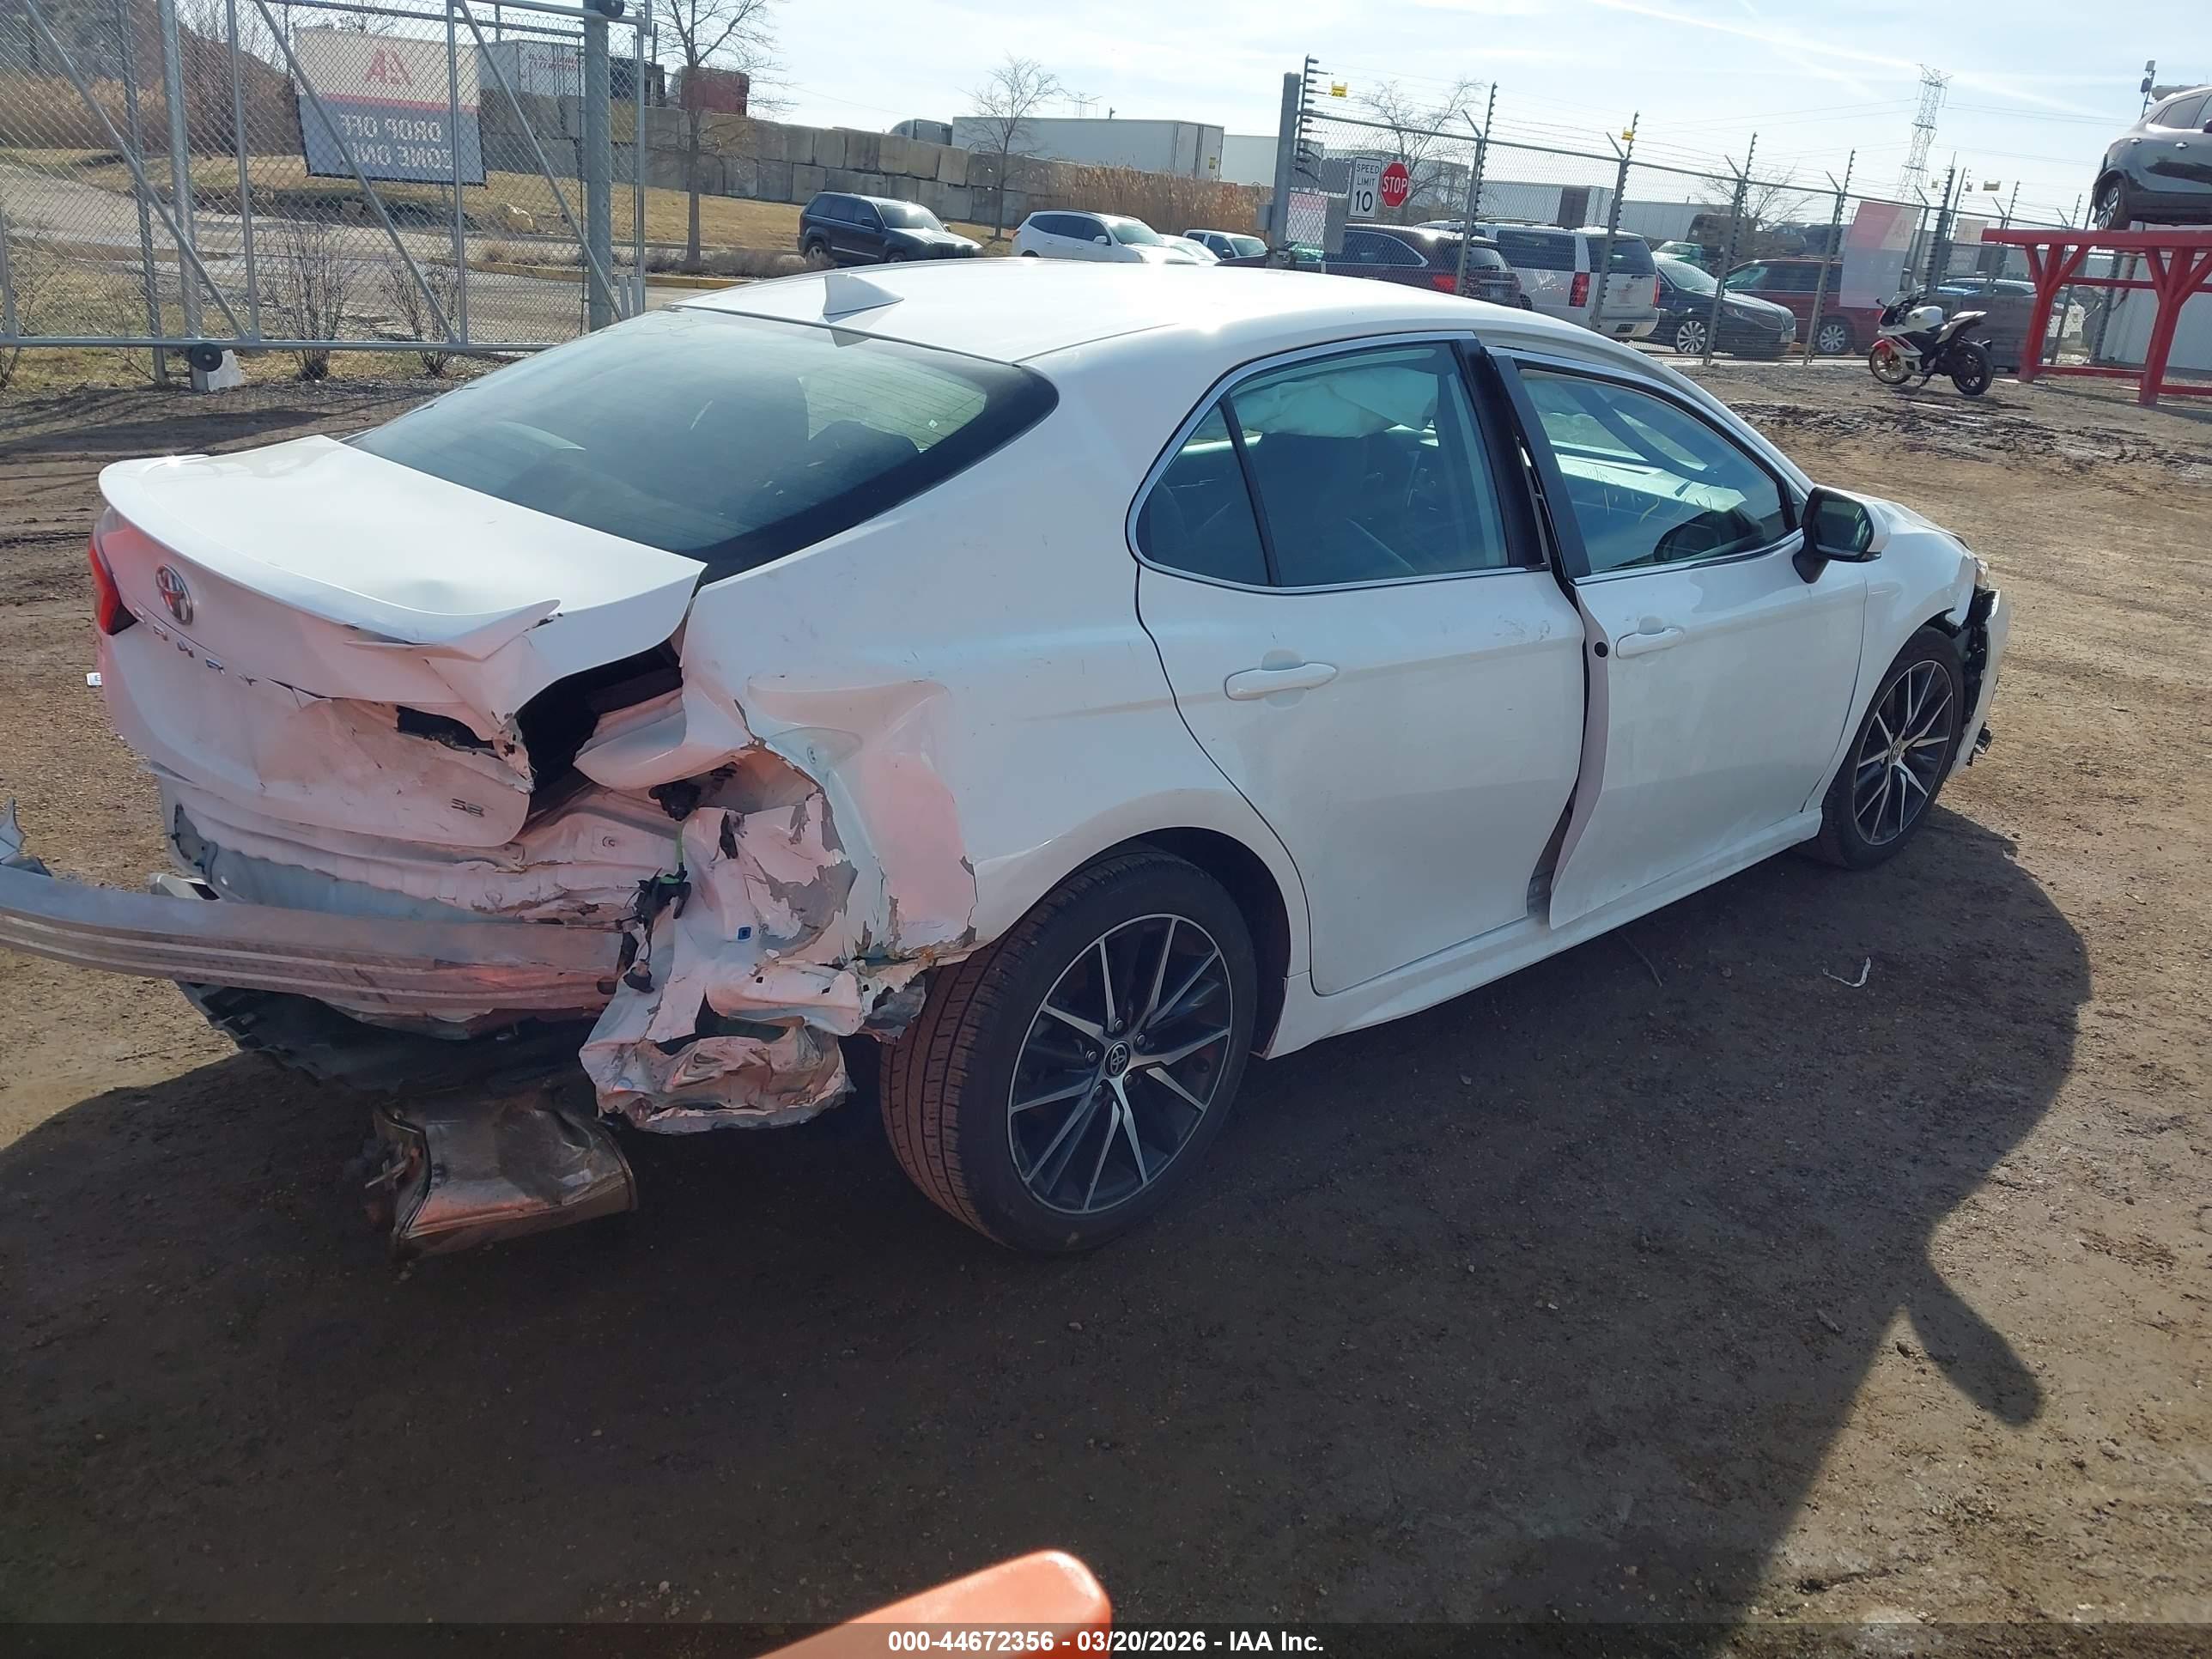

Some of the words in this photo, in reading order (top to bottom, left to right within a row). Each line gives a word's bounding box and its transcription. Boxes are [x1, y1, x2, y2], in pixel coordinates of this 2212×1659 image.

[1356, 163, 1380, 174] SPEED
[1357, 177, 1376, 186] LIMIT
[1382, 176, 1407, 194] STOP
[1356, 190, 1373, 212] 10
[450, 797, 486, 818] SE
